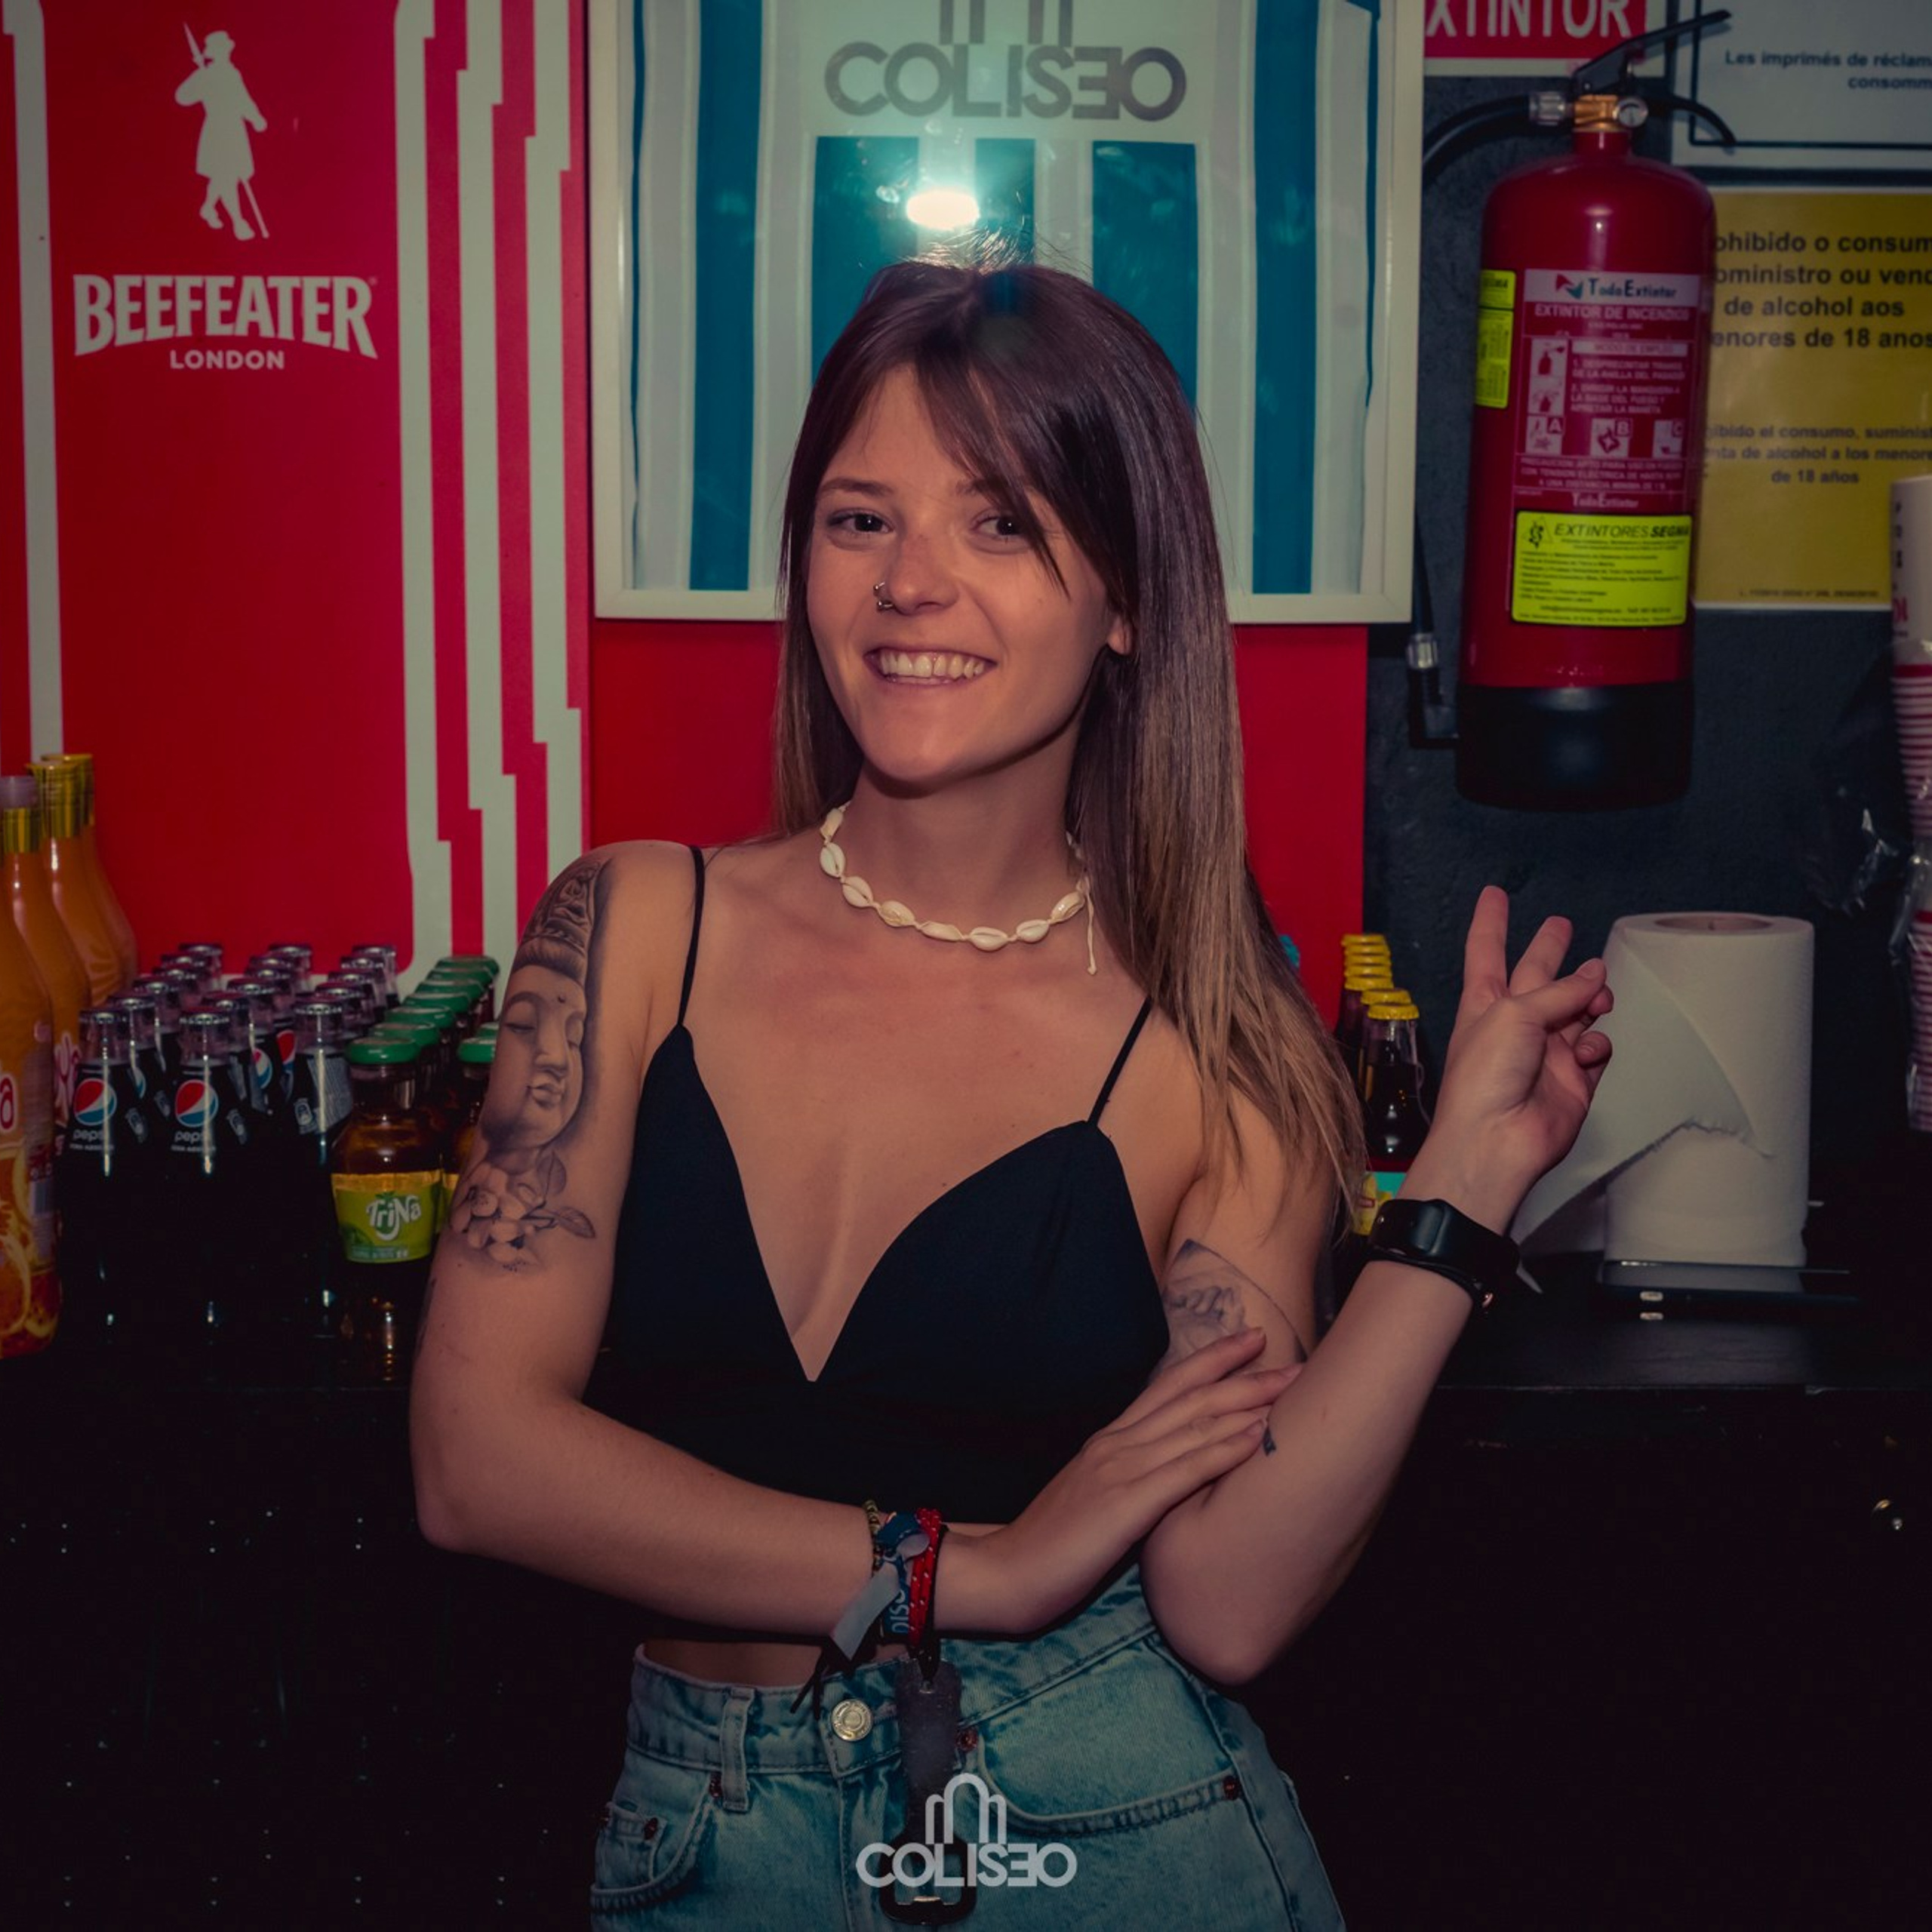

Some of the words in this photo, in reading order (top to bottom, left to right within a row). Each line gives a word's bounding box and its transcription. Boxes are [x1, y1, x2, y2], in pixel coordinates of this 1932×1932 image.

[1724, 51, 1755, 65] Les
[1761, 50, 1841, 69] imprimés
[1847, 51, 1869, 66] de
[1873, 52, 1932, 67] réclam
[825, 42, 1186, 122] COLISEO
[1814, 236, 1829, 252] o
[1840, 269, 1871, 285] ou
[1534, 303, 1601, 318] EXTINTOR
[1604, 306, 1624, 320] DE
[1724, 296, 1753, 316] de
[1761, 296, 1853, 316] alcohol
[1861, 301, 1905, 316] aos
[72, 274, 378, 360] BEEFEATER
[1804, 328, 1835, 348] de
[1844, 328, 1871, 348] 18
[170, 349, 285, 371] LONDON
[1549, 419, 1562, 432] A
[1617, 420, 1629, 435] B
[1715, 426, 1754, 438] bido
[1760, 426, 1774, 438] el
[1742, 446, 1761, 459] de
[1767, 446, 1826, 459] alcohol
[1846, 447, 1870, 460] los
[1771, 469, 1790, 483] de
[1798, 469, 1815, 483] 18
[1821, 469, 1860, 483] años
